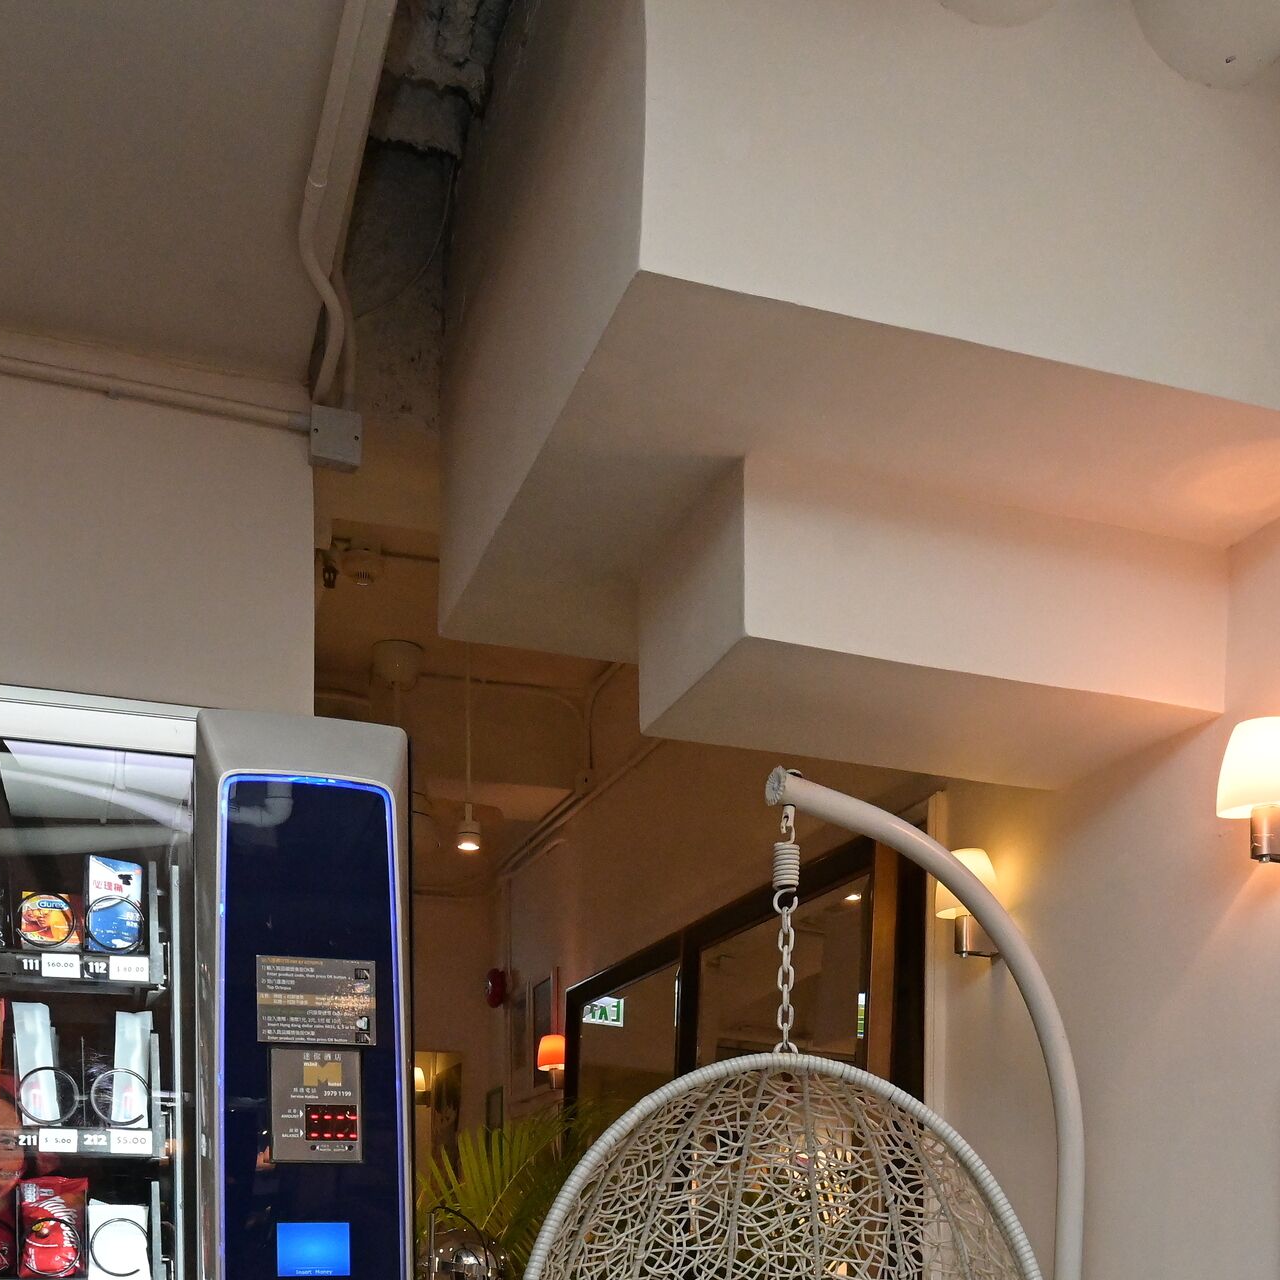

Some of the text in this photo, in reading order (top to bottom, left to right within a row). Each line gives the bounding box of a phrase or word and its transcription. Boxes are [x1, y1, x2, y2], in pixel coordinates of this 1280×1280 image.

[39, 900, 68, 909] durex
[22, 959, 40, 971] 111
[88, 962, 107, 974] 112
[18, 1134, 37, 1146] 211
